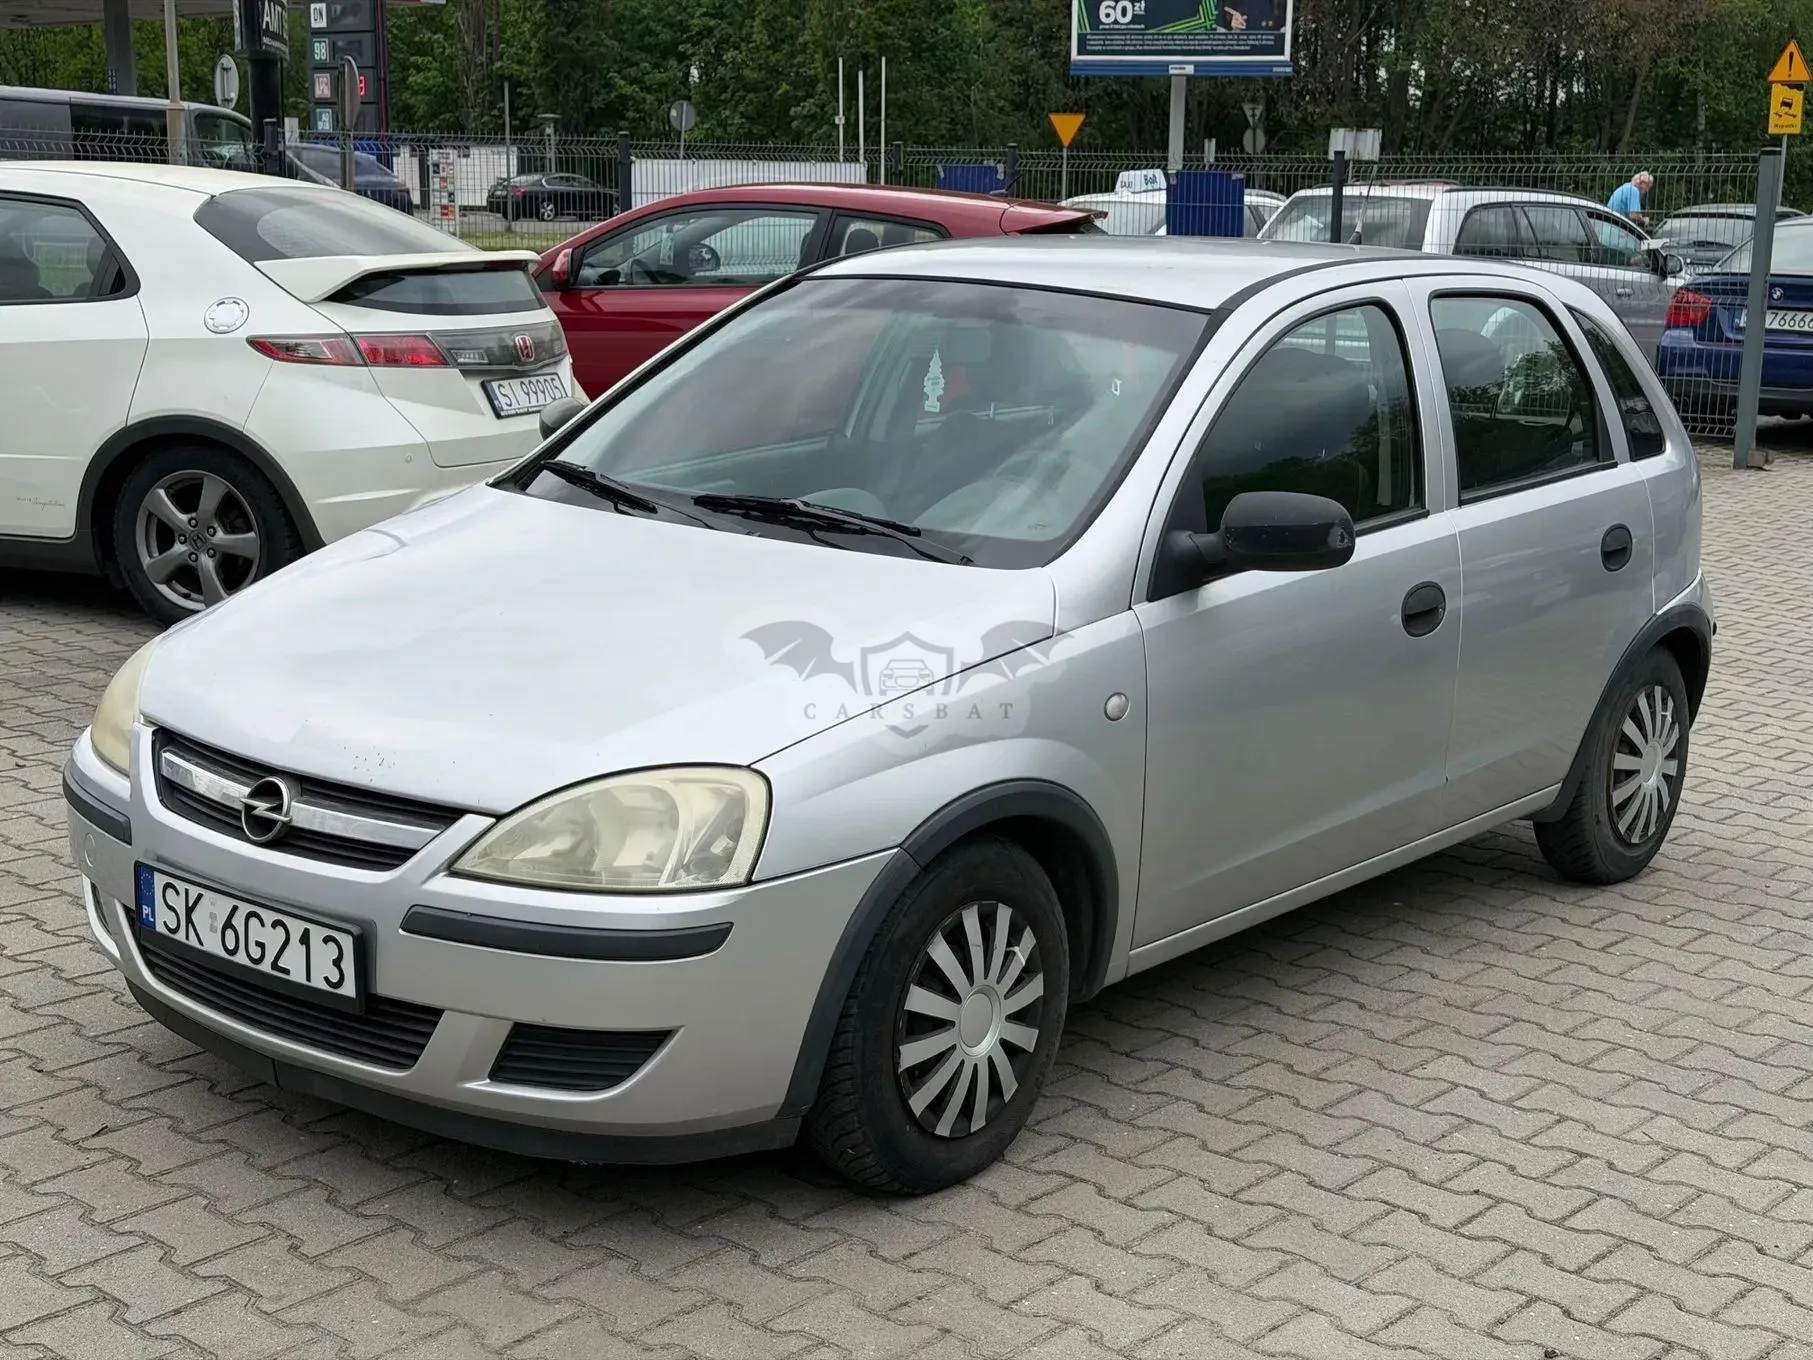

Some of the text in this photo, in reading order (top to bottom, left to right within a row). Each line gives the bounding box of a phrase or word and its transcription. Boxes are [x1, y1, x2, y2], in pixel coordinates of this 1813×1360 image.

[313, 7, 324, 23] ON
[1099, 0, 1133, 24] 60
[314, 42, 326, 60] 98
[497, 377, 563, 407] SI 99905
[142, 904, 155, 921] PL
[161, 881, 345, 989] SK 6G213
